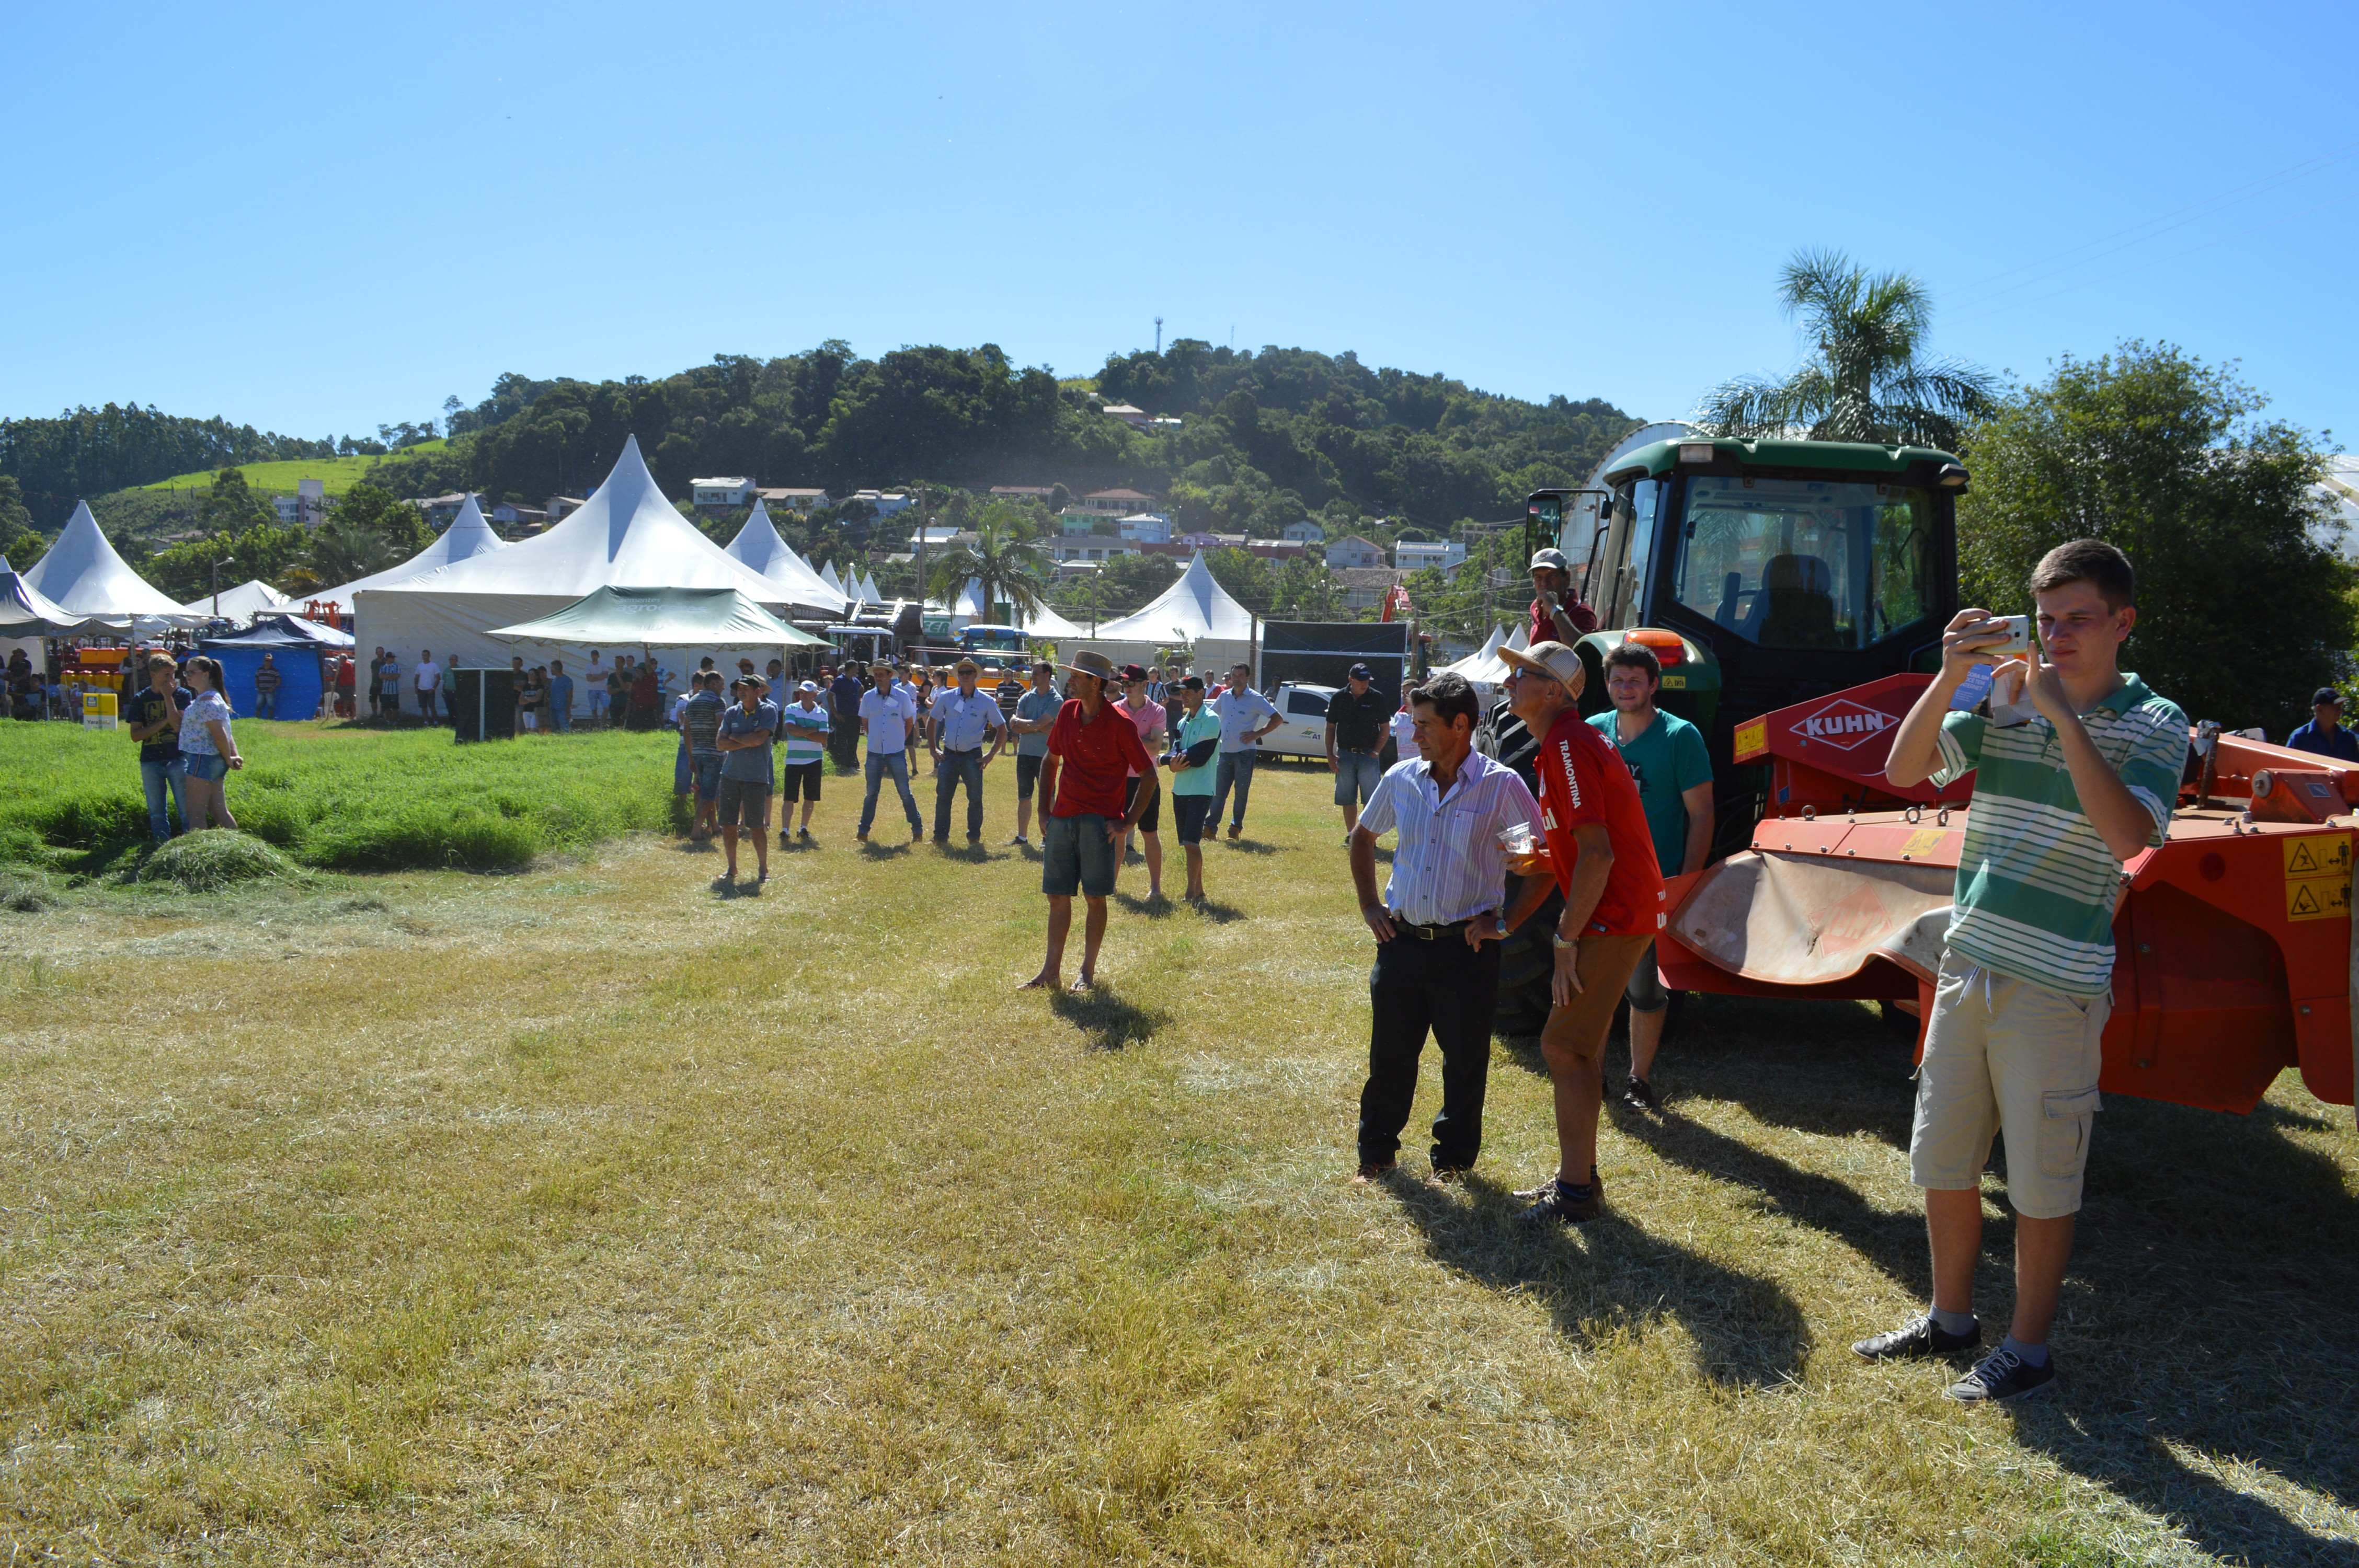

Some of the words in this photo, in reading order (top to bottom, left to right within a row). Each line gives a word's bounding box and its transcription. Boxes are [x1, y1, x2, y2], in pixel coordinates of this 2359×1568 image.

[616, 604, 708, 615] agroceres
[1805, 712, 1885, 737] KUHN
[1559, 739, 1582, 810] TRAMONTINA
[1818, 905, 1890, 940] KUHN
